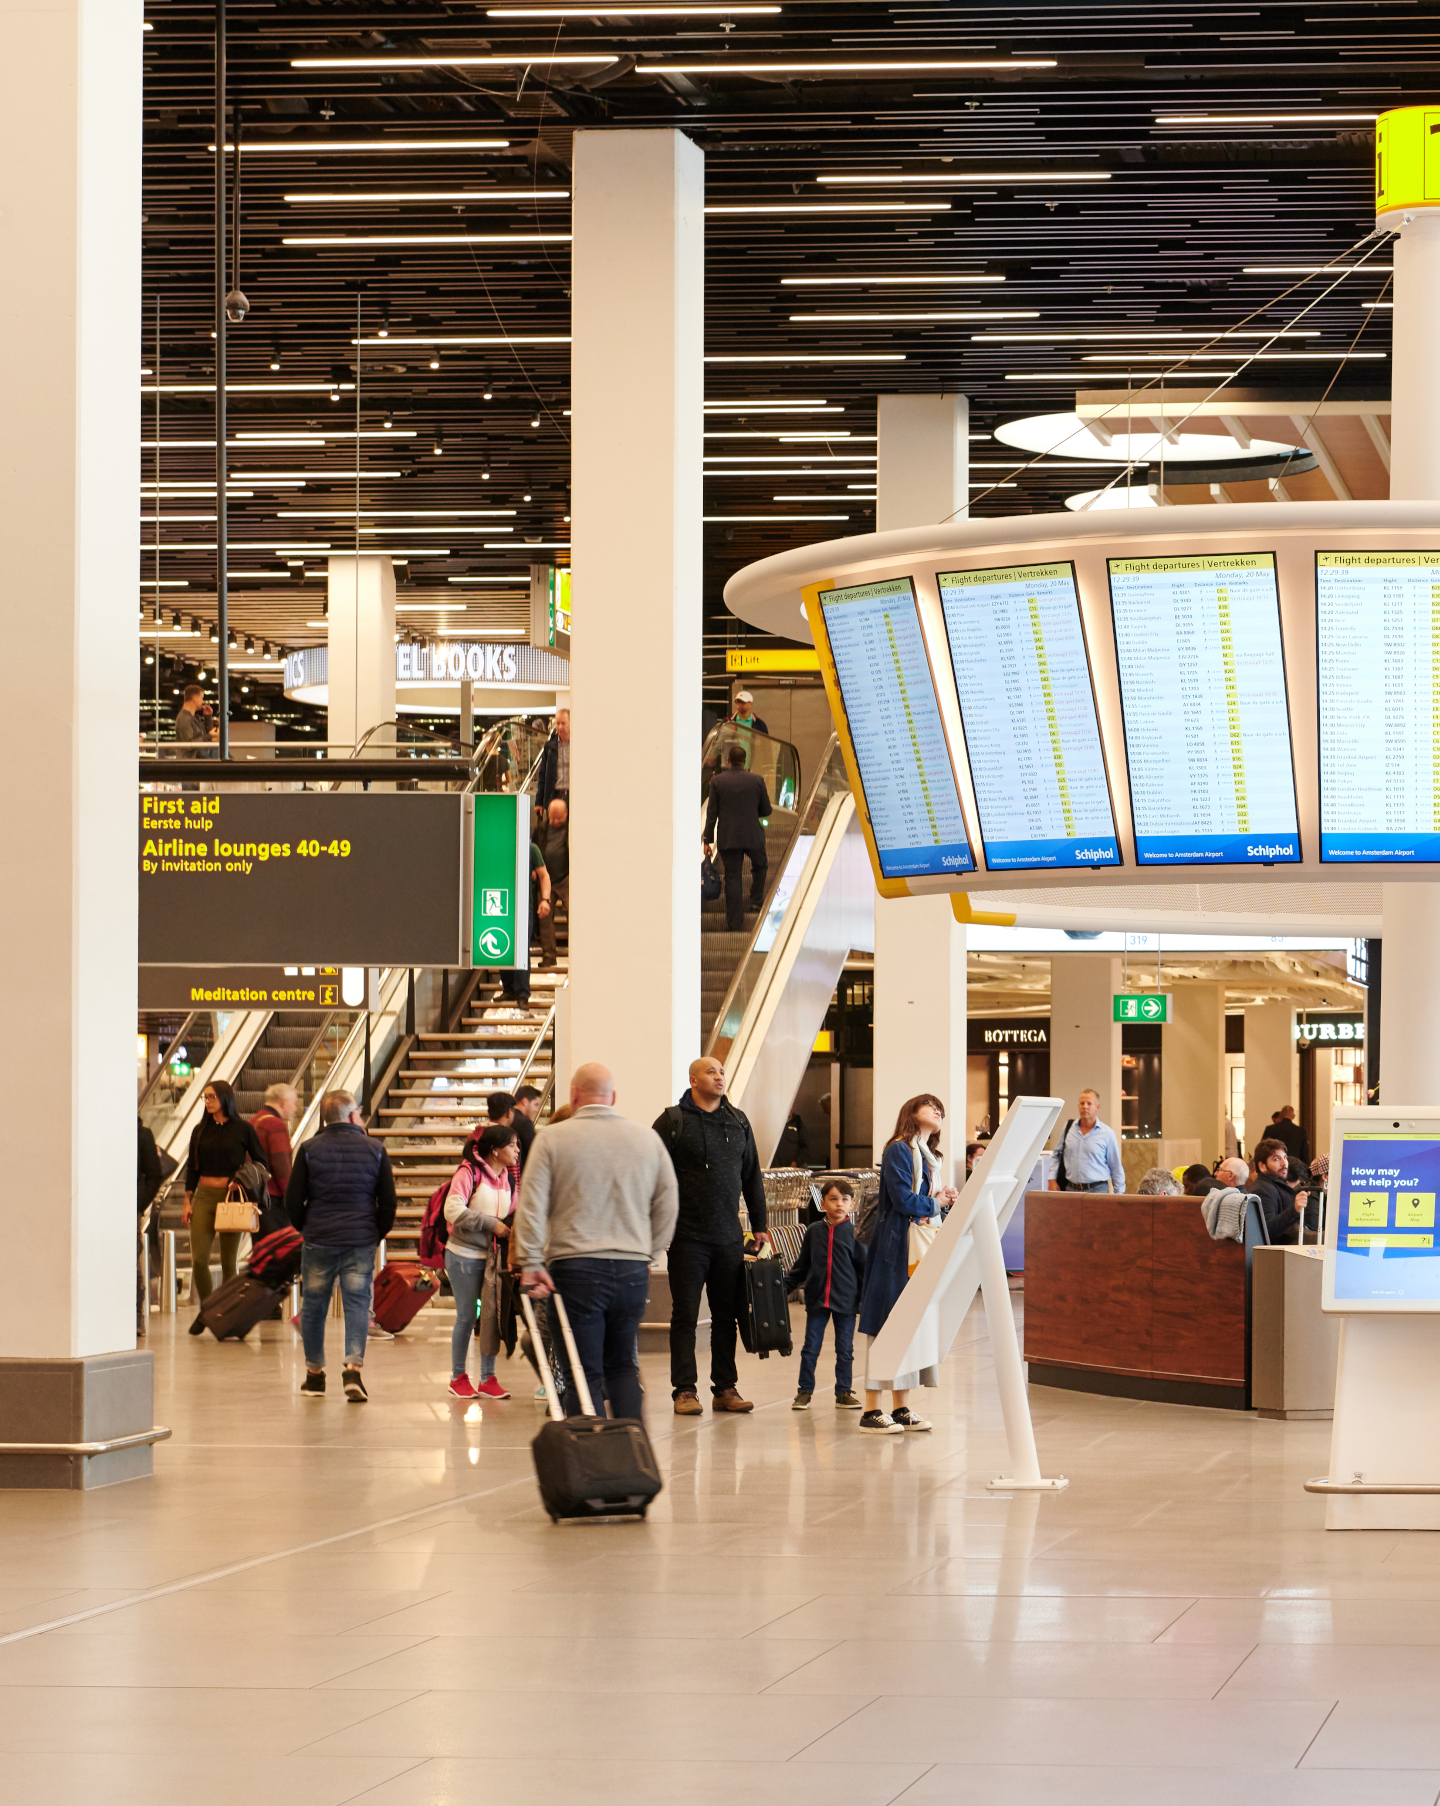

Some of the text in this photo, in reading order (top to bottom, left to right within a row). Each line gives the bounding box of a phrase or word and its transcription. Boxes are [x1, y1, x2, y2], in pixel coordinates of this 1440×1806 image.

[1125, 558, 1256, 572] Flight departures Vertrekken
[1334, 557, 1361, 565] Flight
[1364, 557, 1415, 565] departures
[951, 569, 1057, 585] Flight departures Vertrekken
[829, 585, 901, 603] Flight departures Vertrekken
[432, 644, 517, 681] BOOKS
[746, 655, 759, 664] Lift
[143, 796, 219, 814] First aid
[143, 817, 213, 831] Eerste hulp
[143, 839, 351, 860] Airline lounges 40-49
[1076, 848, 1113, 861] Schiphol
[1247, 845, 1293, 858] Schiphol
[143, 860, 252, 874] By invitation only
[942, 854, 969, 867] Schiphol
[191, 988, 314, 1000] Meditation centre
[985, 1029, 1046, 1042] BOTTEGA
[1352, 1167, 1400, 1177] How may
[1369, 1178, 1391, 1187] help
[1394, 1179, 1419, 1188] you?
